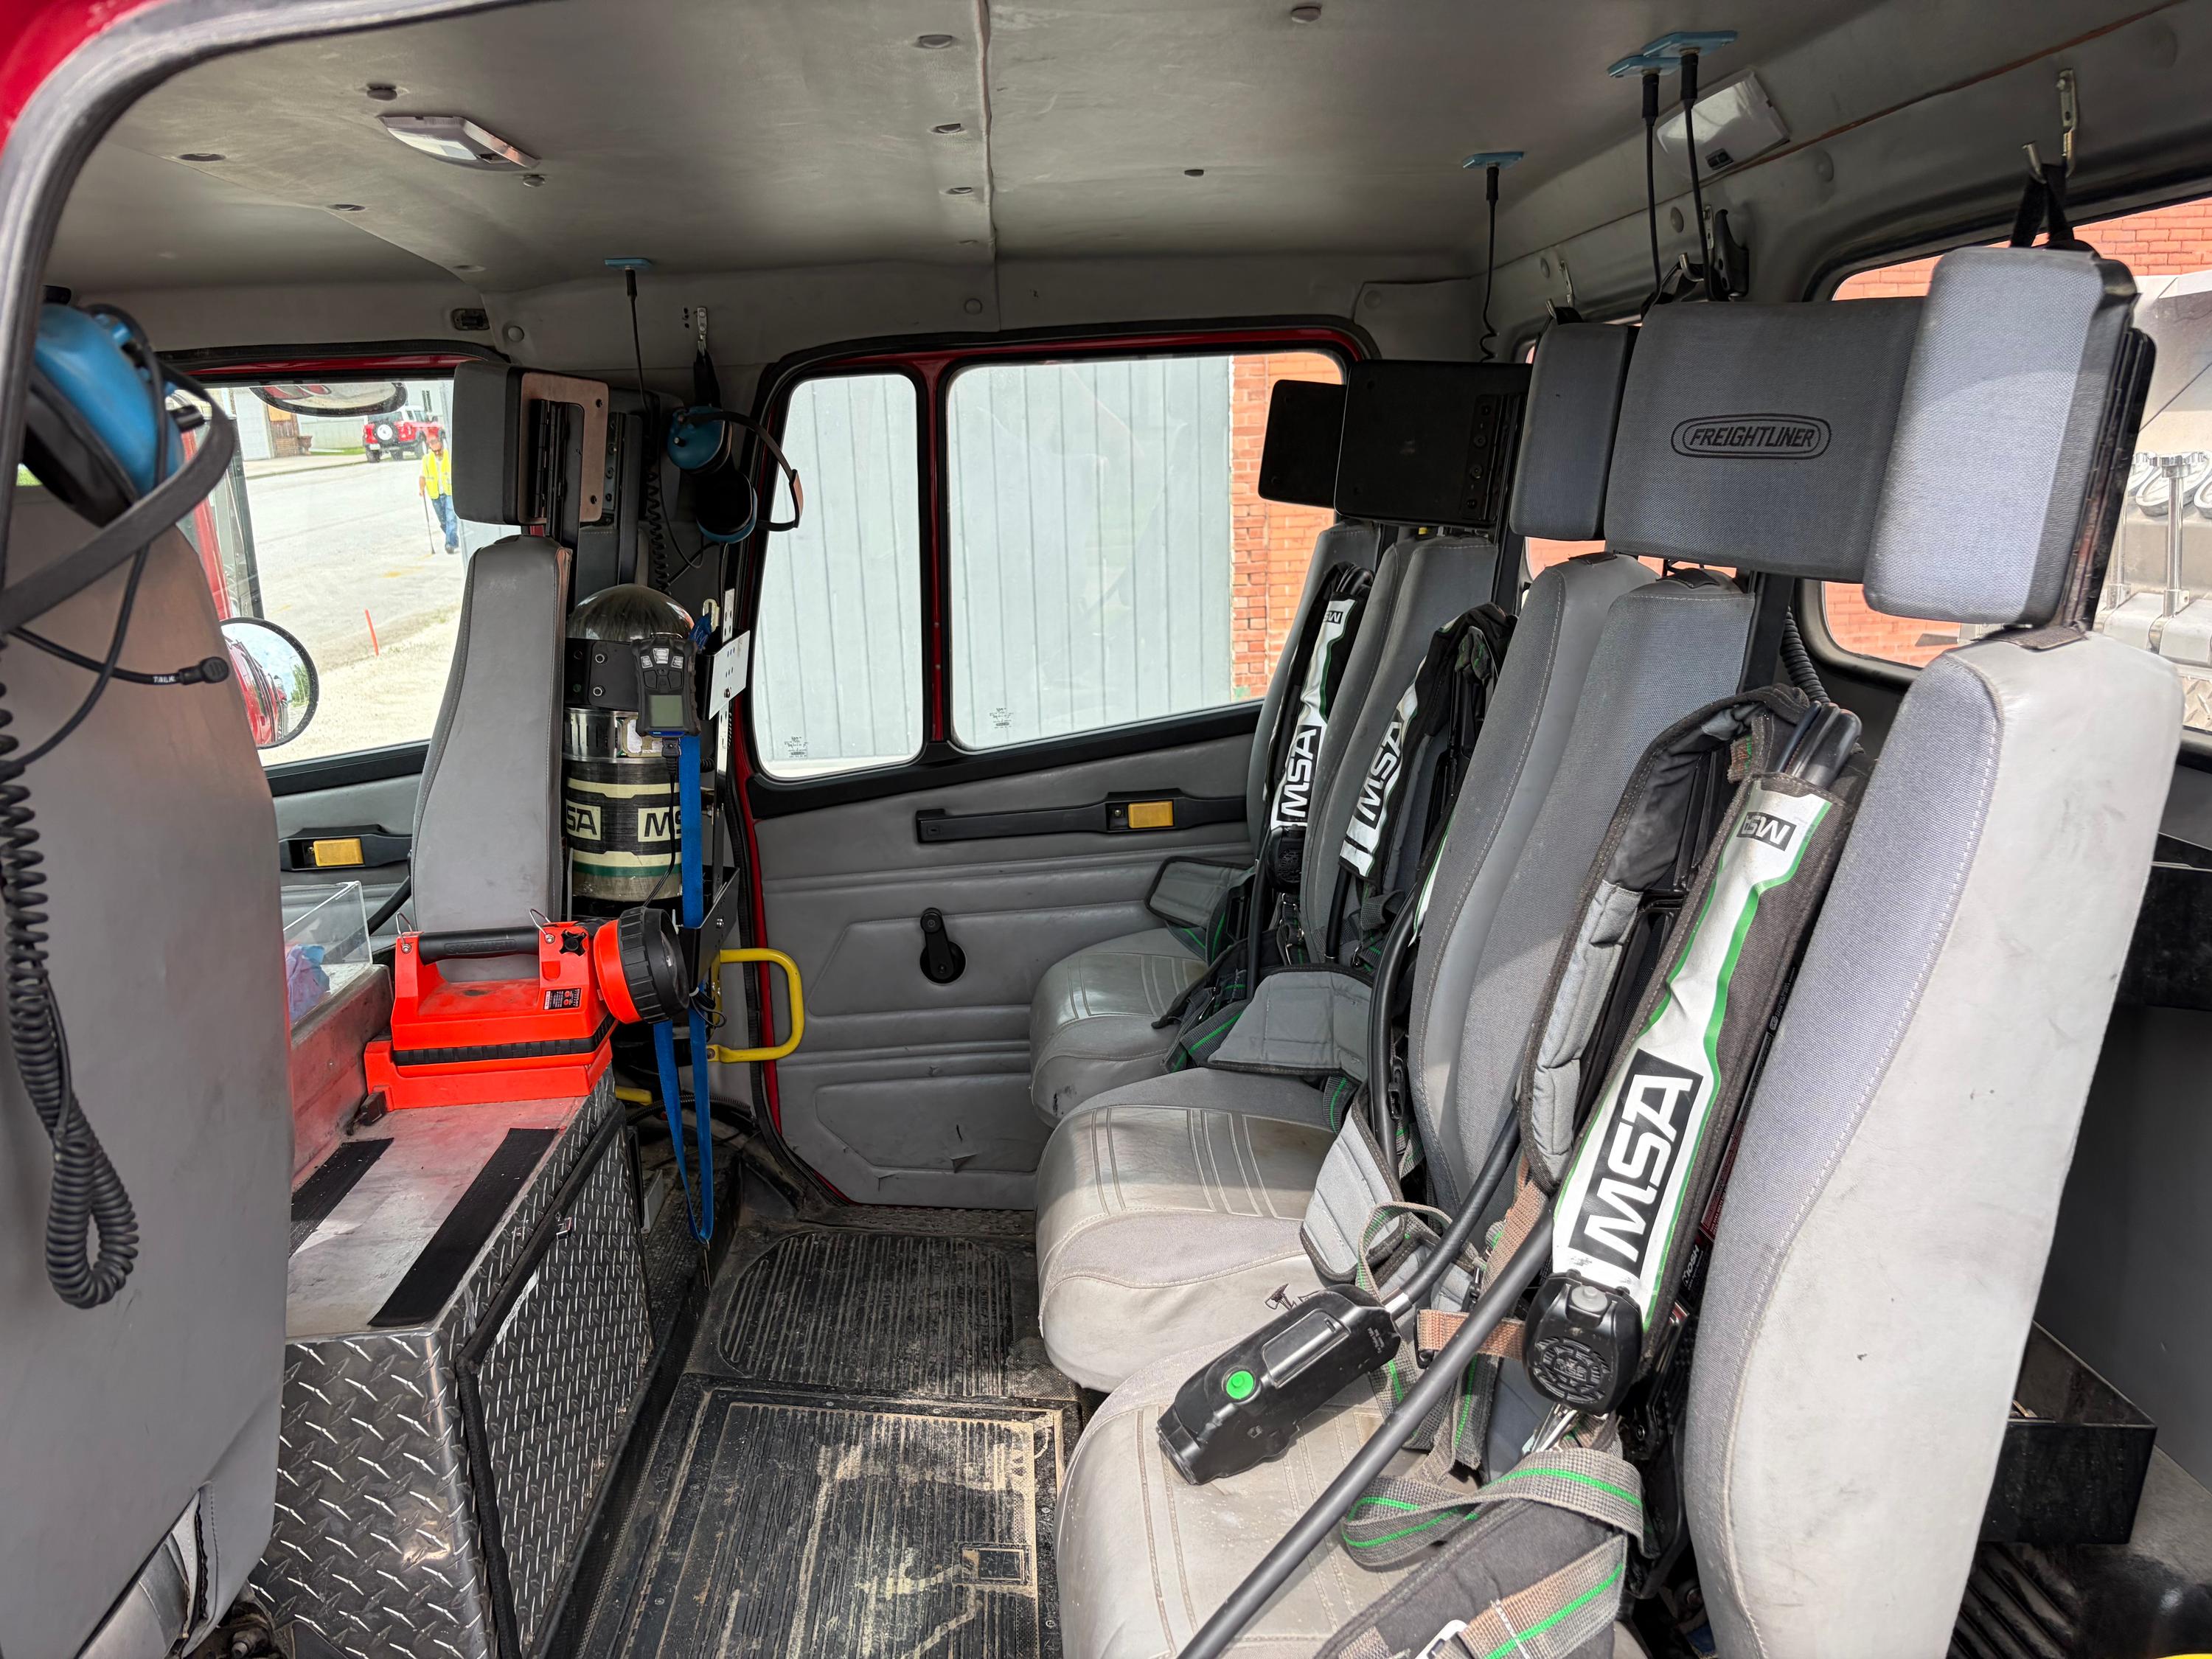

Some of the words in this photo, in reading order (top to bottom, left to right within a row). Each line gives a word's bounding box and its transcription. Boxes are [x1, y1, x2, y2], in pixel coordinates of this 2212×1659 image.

[1690, 426, 1815, 448] FREIGHTLINER
[153, 675, 176, 683] TALK
[1281, 728, 1317, 818] MSA
[1357, 721, 1402, 821] MSA
[566, 805, 597, 835] SA
[1741, 815, 1791, 845] MSA
[1585, 1074, 1694, 1263] MSA
